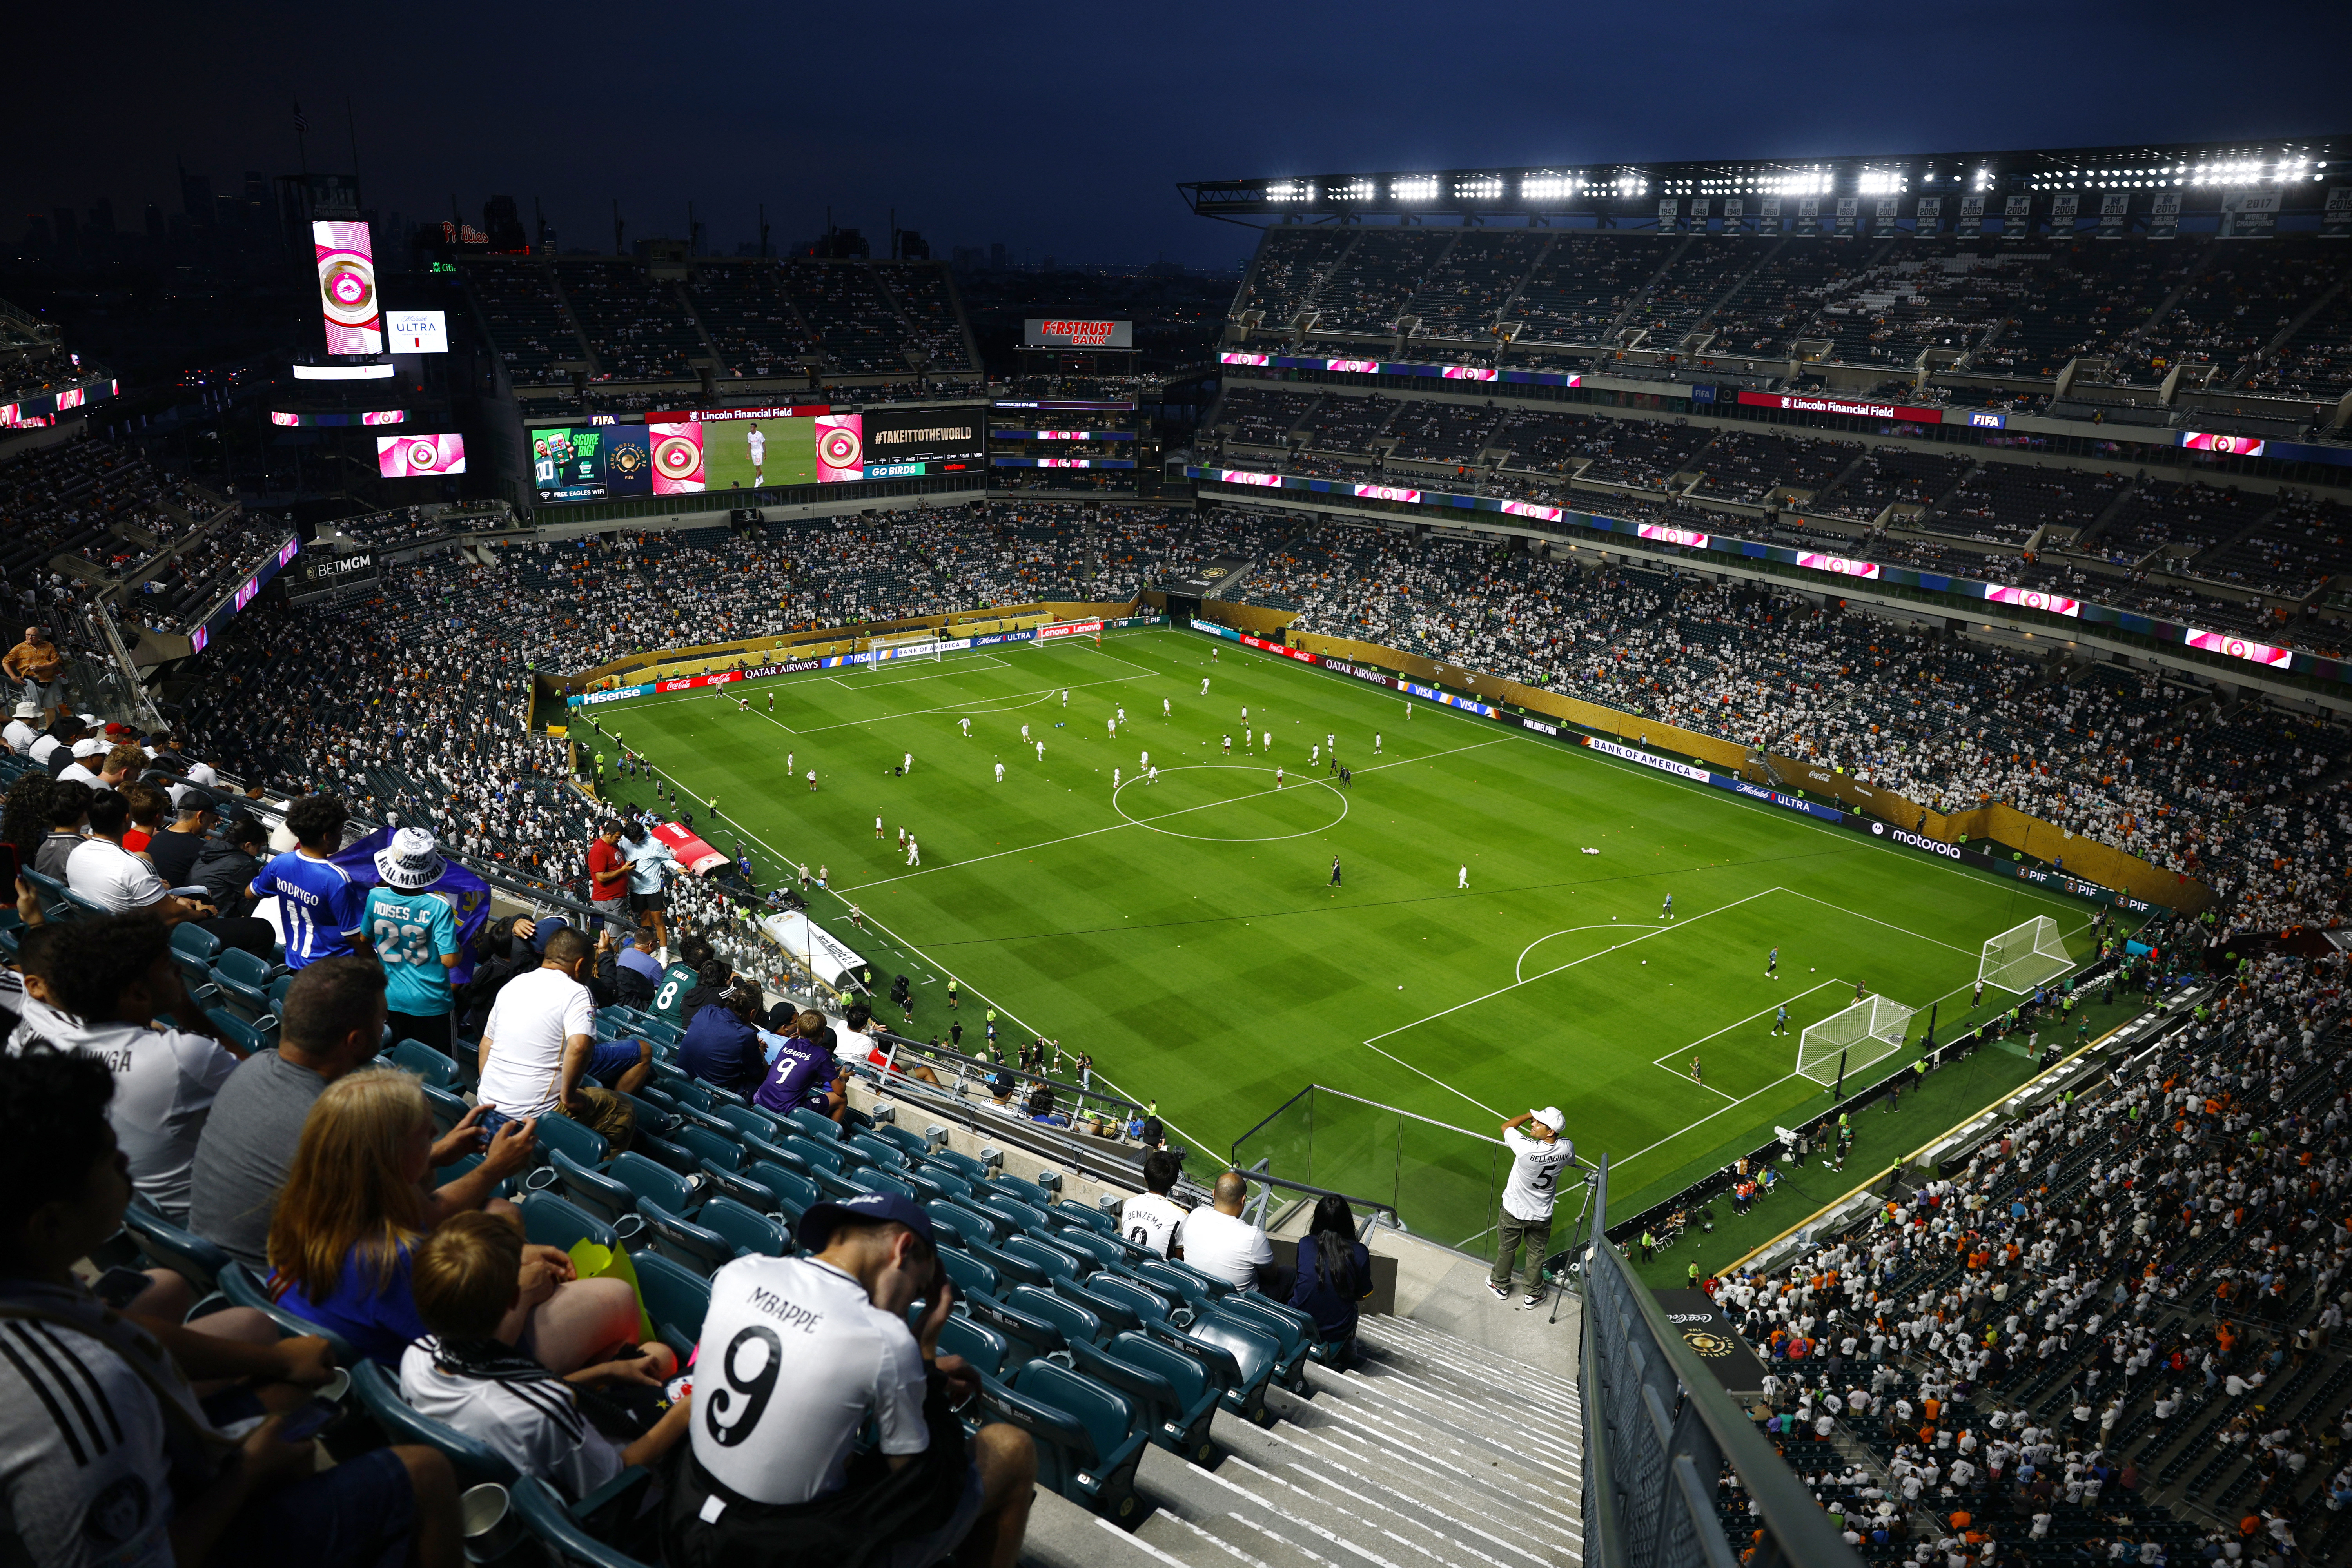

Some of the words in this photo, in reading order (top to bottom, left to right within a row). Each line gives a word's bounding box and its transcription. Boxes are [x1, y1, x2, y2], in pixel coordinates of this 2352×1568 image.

[2007, 206, 2027, 214] 2004
[2055, 206, 2075, 214] 2006
[2104, 205, 2123, 214] 2010
[2156, 204, 2176, 213] 2013
[2246, 198, 2272, 209] 2017
[314, 209, 359, 218] CHAMPIONS
[397, 323, 436, 332] ULTRA
[1072, 336, 1106, 345] BANK
[1695, 390, 1710, 398] FIFA
[702, 410, 733, 421] Lincoln
[734, 409, 771, 419] Financial
[772, 407, 792, 417] Field
[1793, 399, 1826, 411] Lincoln
[1827, 402, 1869, 415] Financial
[1870, 405, 1894, 417] Field
[592, 415, 615, 425] FIFA
[1973, 414, 2000, 427] FIFA
[573, 433, 599, 446] SCORE
[875, 426, 971, 444] #TAKEITTOTHEWORLD
[578, 445, 595, 457] BIG!
[614, 442, 635, 452] WORLD
[637, 446, 646, 458] CUP
[872, 467, 887, 476] GO
[888, 465, 916, 475] BIRDS
[318, 554, 371, 577] BETMGM
[1042, 628, 1068, 637] Lenovo
[1073, 623, 1101, 632] Lenovo
[1190, 619, 1221, 636] Hisense
[976, 635, 1002, 646] Michelob
[1007, 632, 1031, 641] ULTRA
[1244, 635, 1259, 647] Coca-Cola
[898, 647, 917, 657] BANK
[919, 646, 930, 654] OF
[931, 642, 960, 652] AMERICA
[1269, 643, 1284, 654] Coca-Cola
[1294, 650, 1310, 661] Coca-Cola
[745, 666, 779, 679] QATAR
[780, 660, 819, 674] AIRWAYS
[1325, 659, 1352, 674] QATAR
[1353, 667, 1387, 684] AIRWAYS
[666, 679, 691, 691] Coca-Cola
[707, 673, 731, 684] Coca-Cola
[583, 688, 641, 705] Hisense
[1414, 685, 1433, 698] VISA
[1458, 699, 1478, 712] VISA
[1523, 718, 1557, 736] PHILADELPHIA
[1594, 740, 1622, 757] BANK
[1626, 749, 1639, 759] OF
[1640, 753, 1691, 776] AMERICA
[1809, 770, 1830, 782] Coca-Cola
[1736, 783, 1769, 799] Michelob
[1777, 794, 1811, 811] ULTRA
[1855, 785, 1873, 797] Hisense
[669, 825, 690, 838] Salzburg
[1893, 829, 1960, 859] motorola
[378, 856, 396, 882] REAL
[398, 864, 442, 886] MADRID
[2029, 869, 2047, 882] PIF
[276, 877, 319, 906] RODRYGO
[2078, 884, 2097, 897] PIF
[2129, 899, 2149, 912] PIF
[373, 901, 410, 920] MOISES
[414, 909, 431, 924] JC
[286, 900, 314, 958] 11
[373, 919, 429, 966] 23
[818, 935, 830, 946] Real
[827, 944, 845, 958] Madrid
[672, 970, 689, 981] KAKA
[657, 981, 679, 1010] 8
[782, 1047, 812, 1061] MBAPPÉ
[775, 1058, 798, 1084] 9
[1530, 1153, 1569, 1163] BELLINGHAM
[1532, 1165, 1557, 1190] 5
[1128, 1210, 1163, 1230] BENZEMA
[746, 1287, 824, 1334] MBAPPÉ
[1722, 1336, 1735, 1350] CLUB
[1700, 1349, 1733, 1357] WORLD
[706, 1326, 783, 1448] 9
[1739, 1502, 1744, 1510] 5
